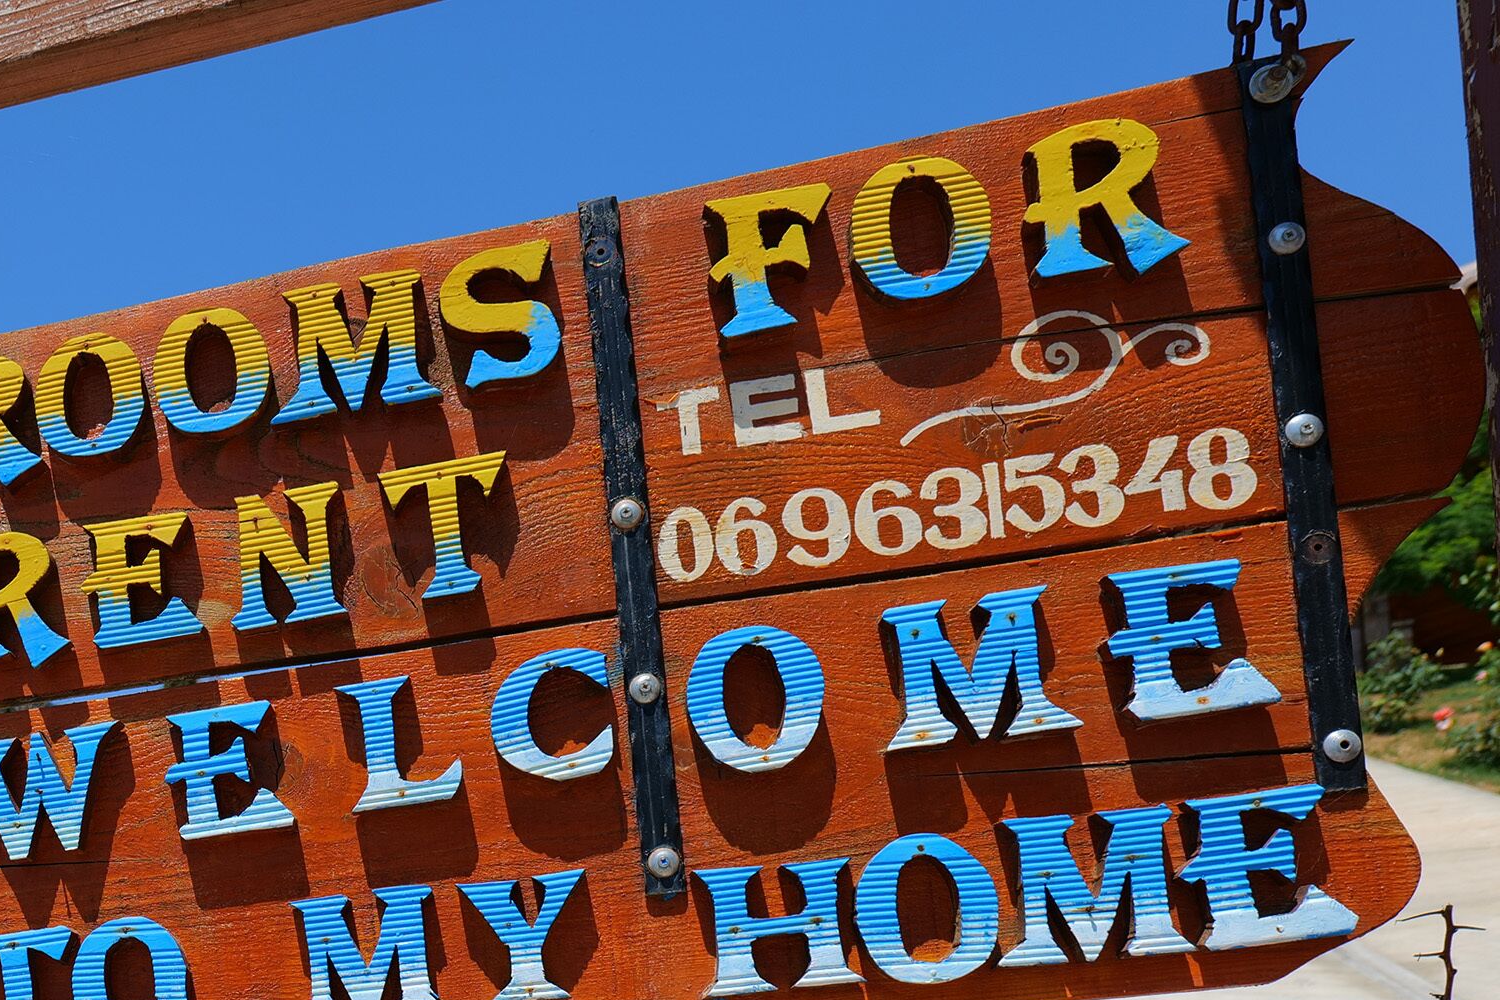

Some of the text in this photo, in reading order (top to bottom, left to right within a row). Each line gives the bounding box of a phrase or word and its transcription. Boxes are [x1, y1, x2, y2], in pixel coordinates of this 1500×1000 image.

[704, 118, 1190, 338] FOR
[656, 368, 882, 455] TEL
[657, 427, 1258, 583] 0696315348
[694, 783, 1359, 999] HOME
